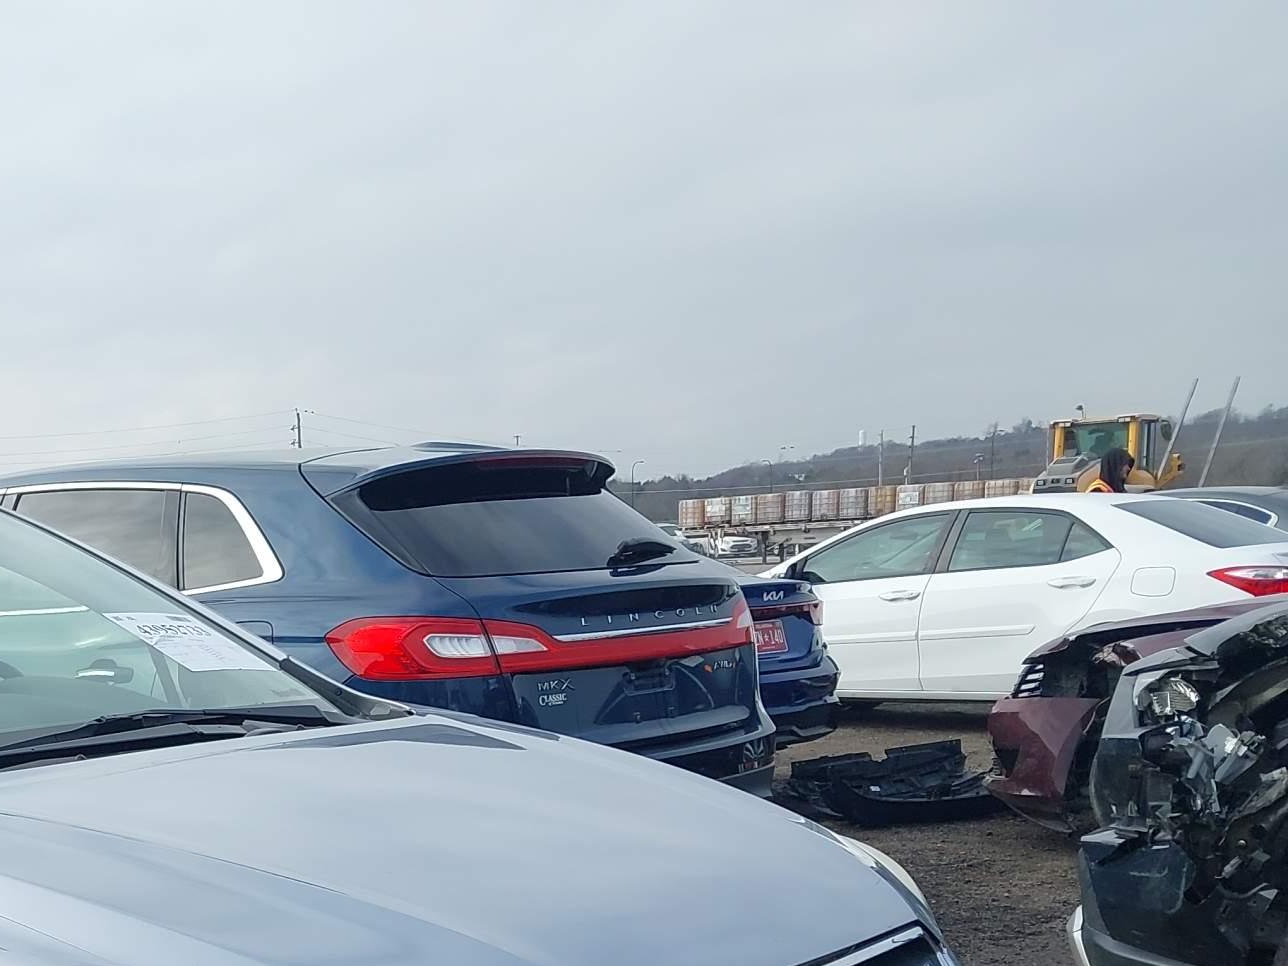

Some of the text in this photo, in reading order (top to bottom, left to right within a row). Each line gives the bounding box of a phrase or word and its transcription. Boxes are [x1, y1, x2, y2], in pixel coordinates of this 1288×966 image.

[580, 605, 718, 627] LINCOLN
[537, 678, 576, 692] MKX
[538, 692, 568, 706] CLASSIC
